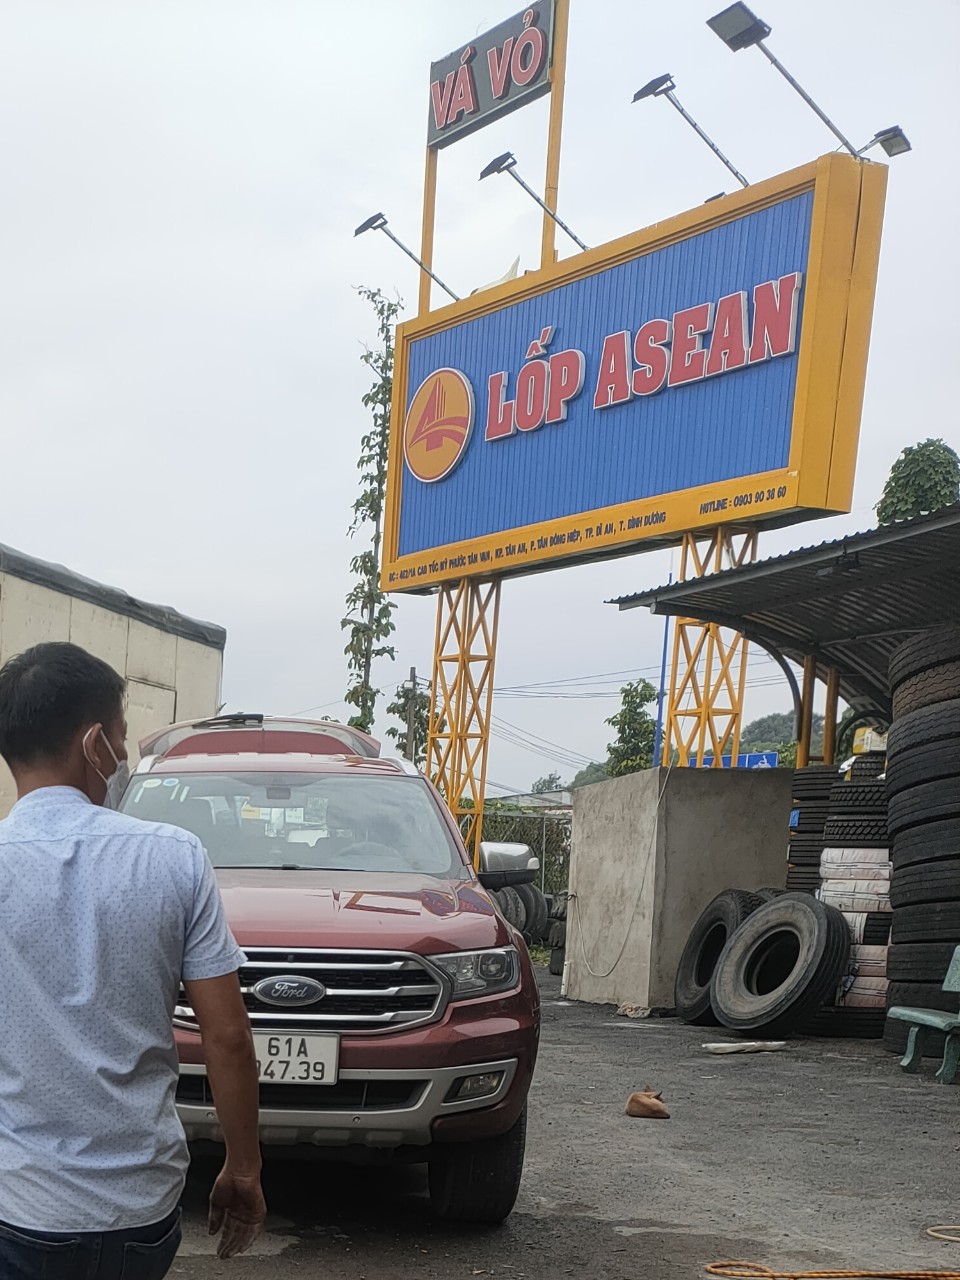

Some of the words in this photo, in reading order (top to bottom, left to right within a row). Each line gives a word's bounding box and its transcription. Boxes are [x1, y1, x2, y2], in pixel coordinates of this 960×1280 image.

[431, 46, 476, 130] VÁ
[487, 9, 545, 100] VỎ
[485, 326, 585, 441] LỐP
[594, 271, 802, 409] ASEAN
[733, 492, 753, 507] 0903
[754, 490, 765, 504] 90
[777, 485, 787, 499] 60
[271, 981, 307, 998] Ford
[267, 1037, 308, 1057] 61A
